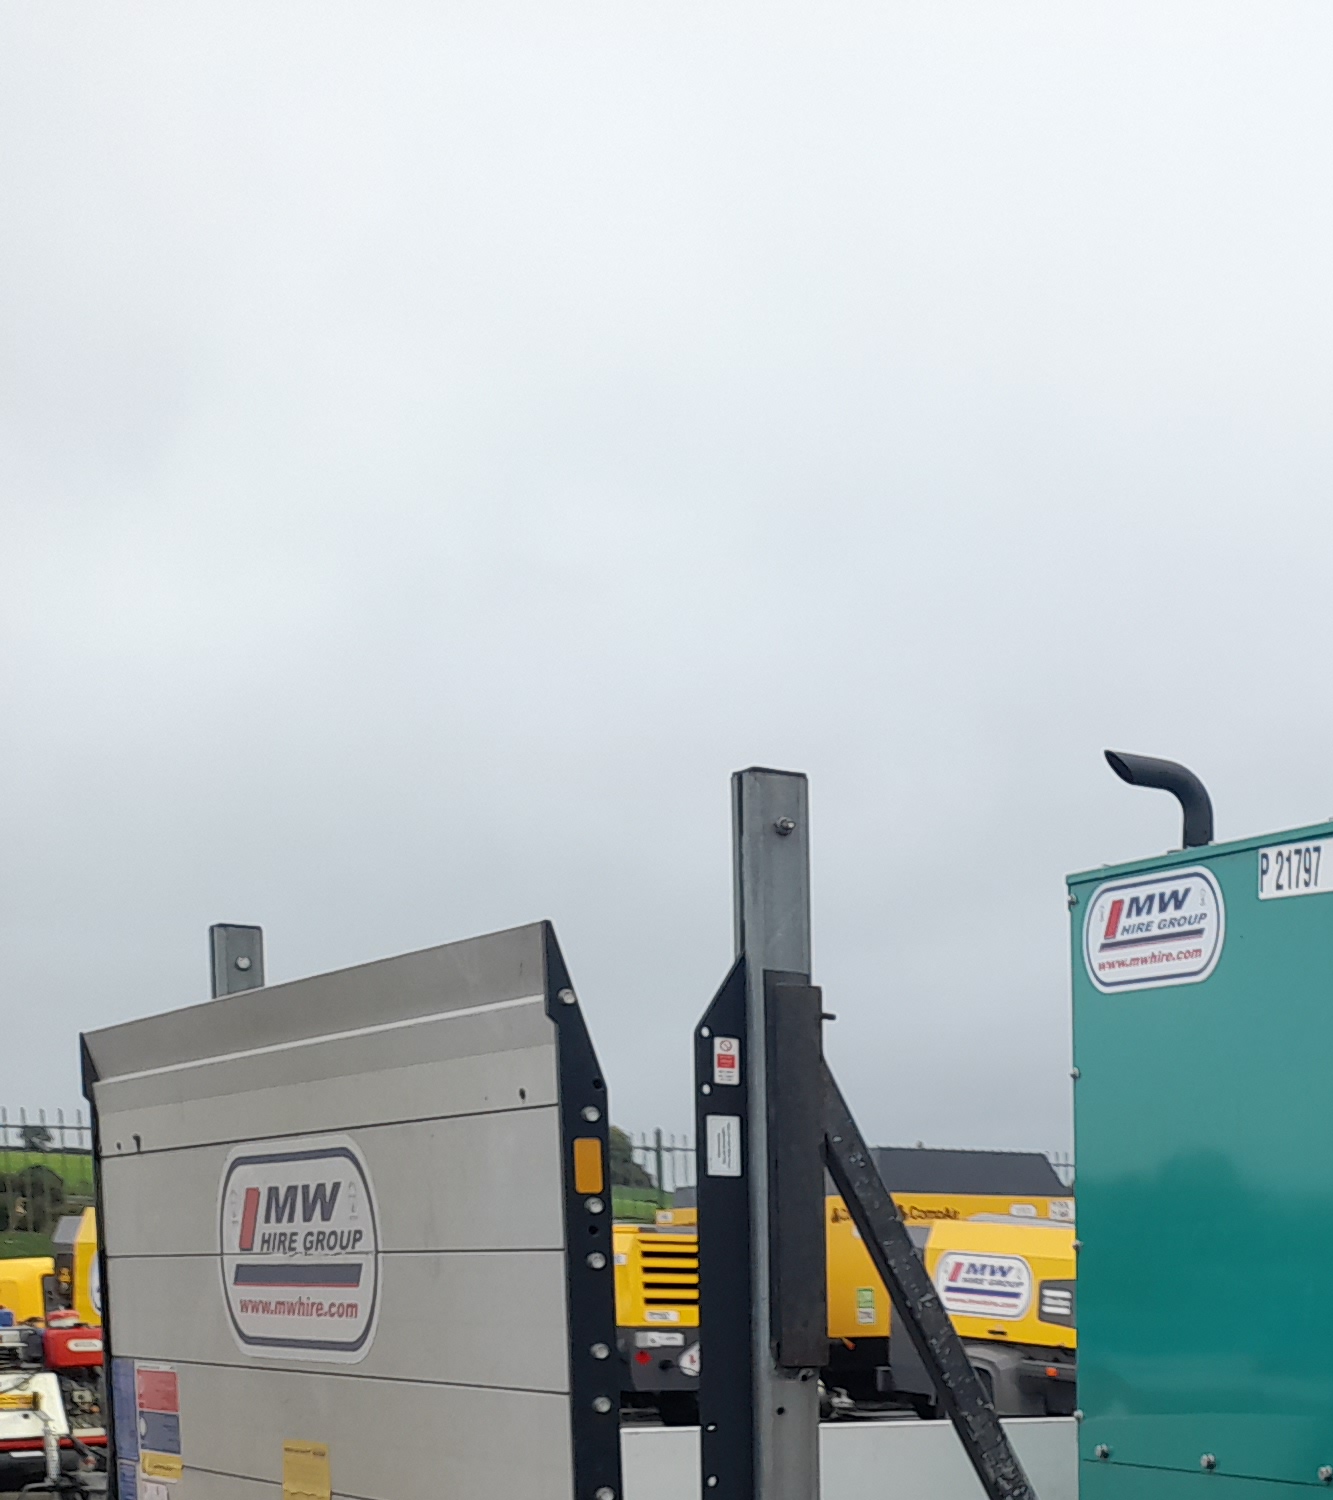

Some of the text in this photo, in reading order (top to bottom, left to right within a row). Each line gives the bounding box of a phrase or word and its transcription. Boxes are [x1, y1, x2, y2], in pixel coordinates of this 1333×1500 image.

[1260, 847, 1322, 893] P 21797
[1126, 887, 1191, 919] MW
[1120, 912, 1208, 936] HIRE GROUP
[1098, 948, 1202, 972] www.mwhire.com
[263, 1181, 341, 1224] MW
[260, 1229, 363, 1253] HIRE GROUP
[965, 1262, 1014, 1278] MW
[239, 1296, 358, 1319] www.mwhire.com
